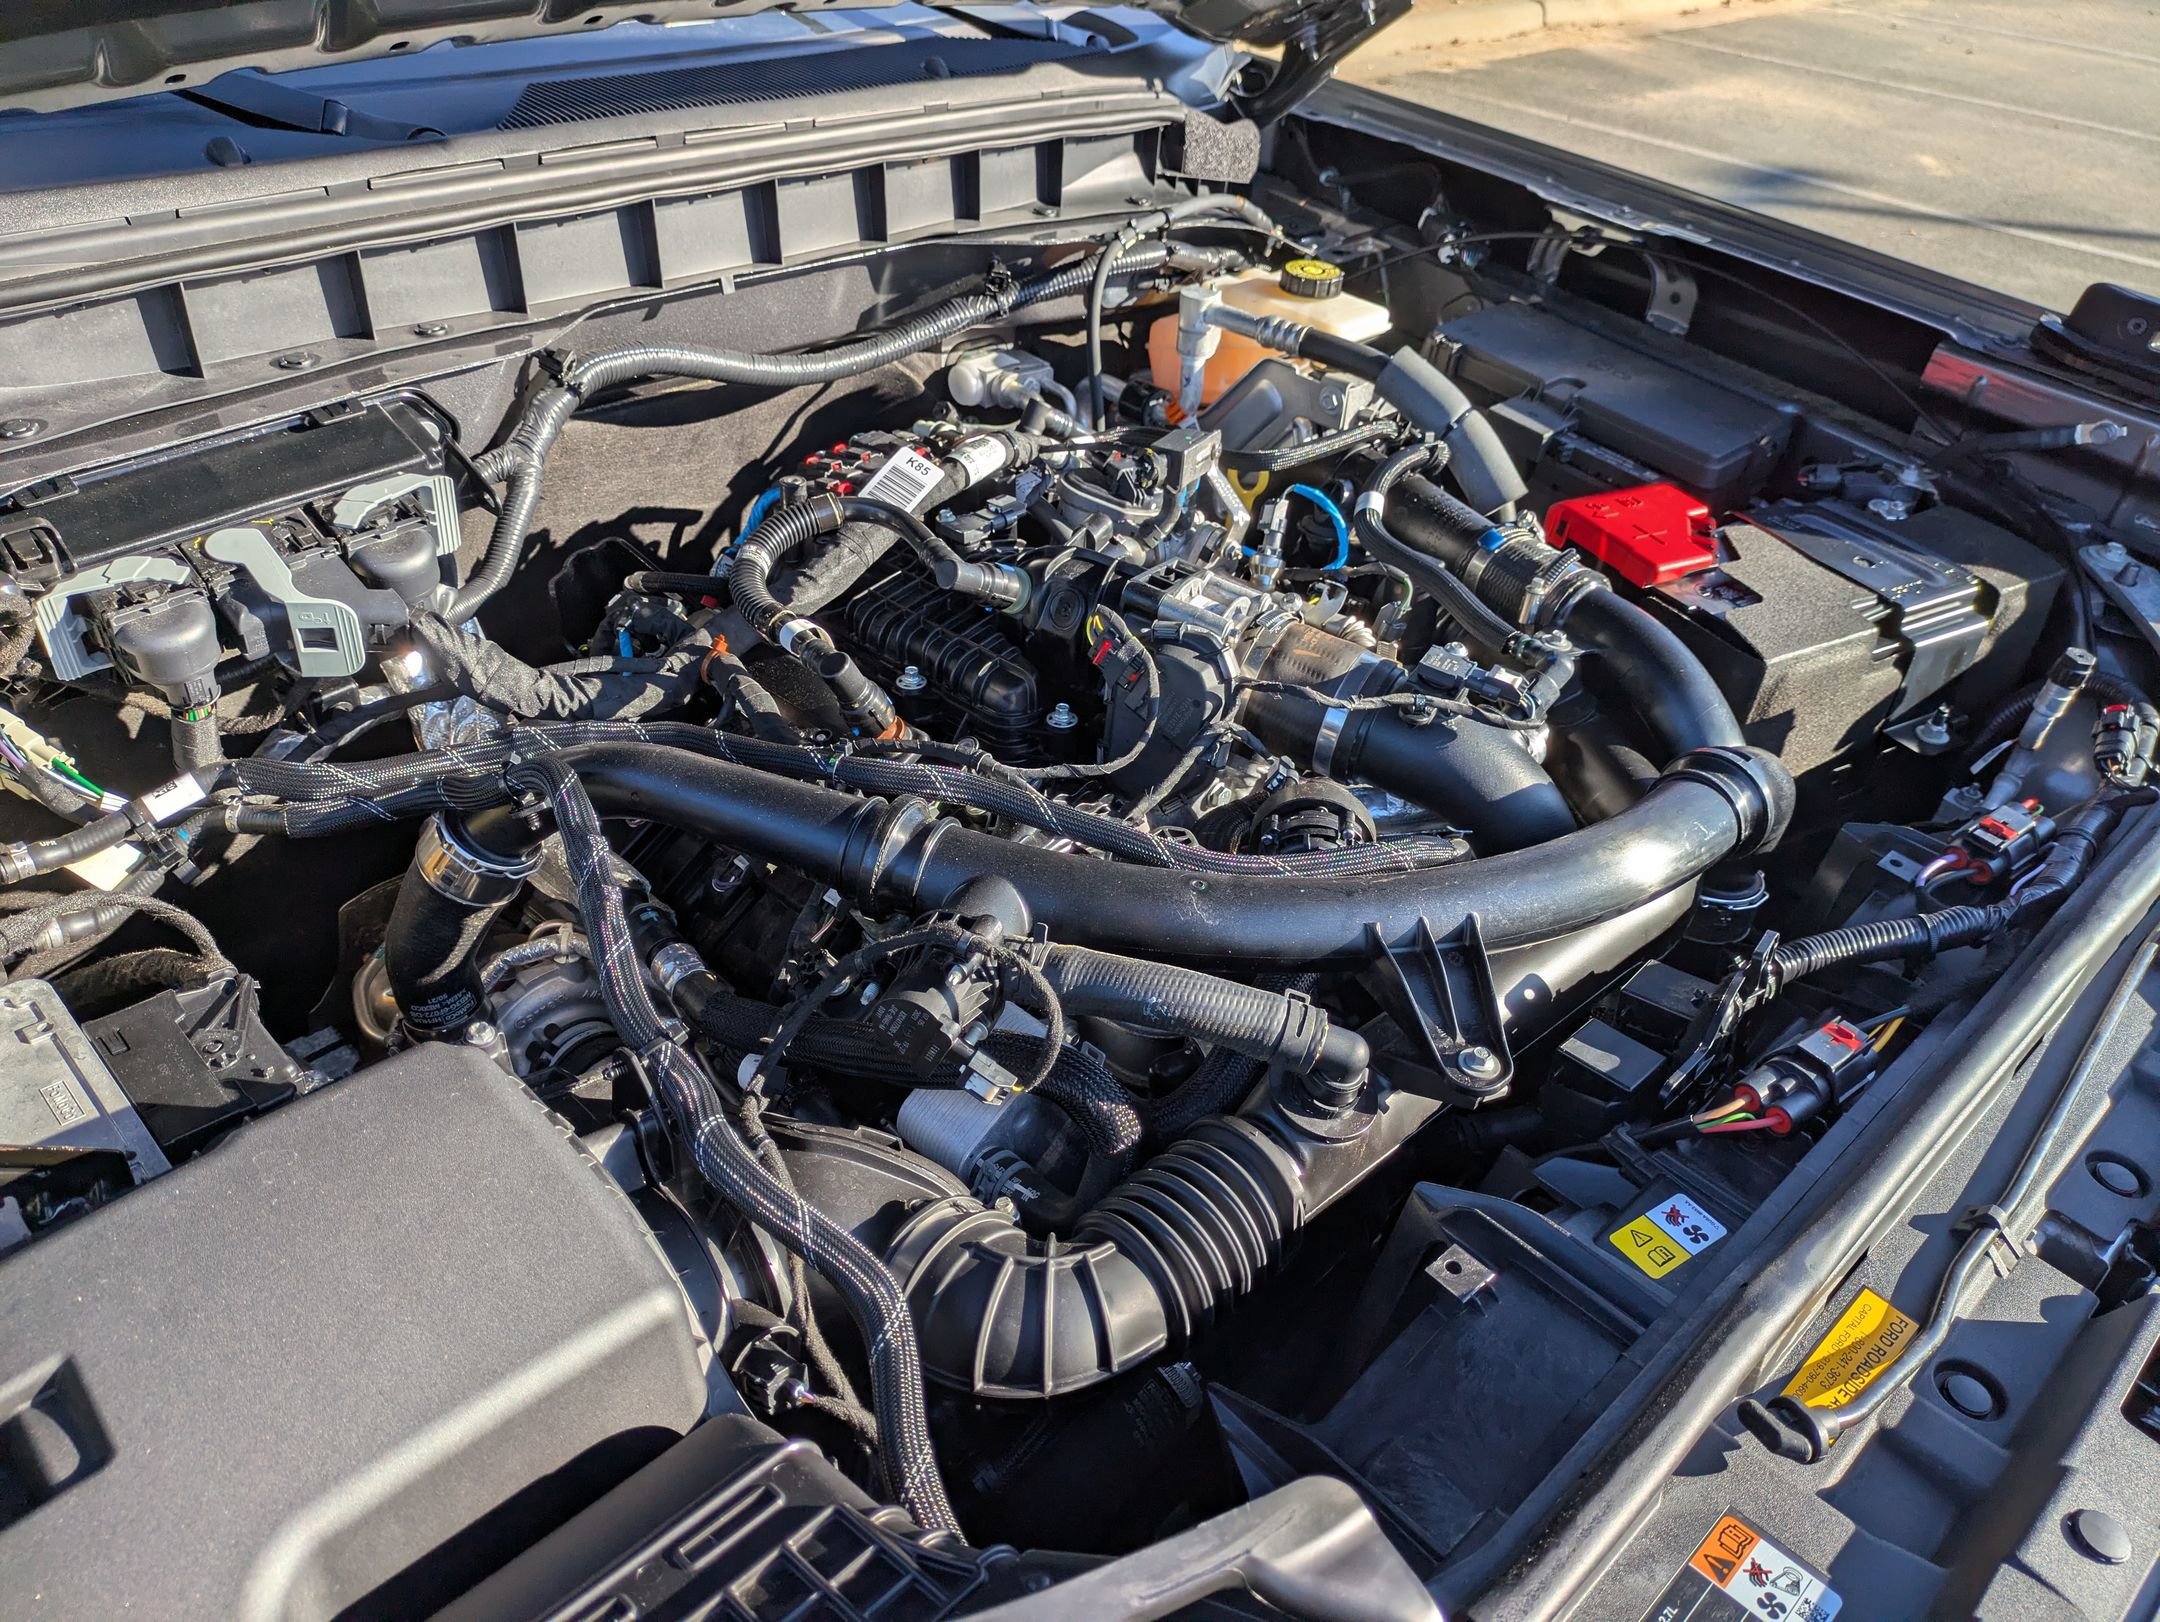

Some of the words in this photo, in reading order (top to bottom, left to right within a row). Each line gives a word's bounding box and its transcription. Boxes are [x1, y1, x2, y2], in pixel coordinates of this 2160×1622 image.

[905, 456, 932, 476] K85
[1847, 1303, 1872, 1330] CAPITAL
[1831, 1331, 1851, 1350] FORD
[1880, 1315, 1909, 1348] FORD
[1837, 1343, 1887, 1399] ROADSIDE
